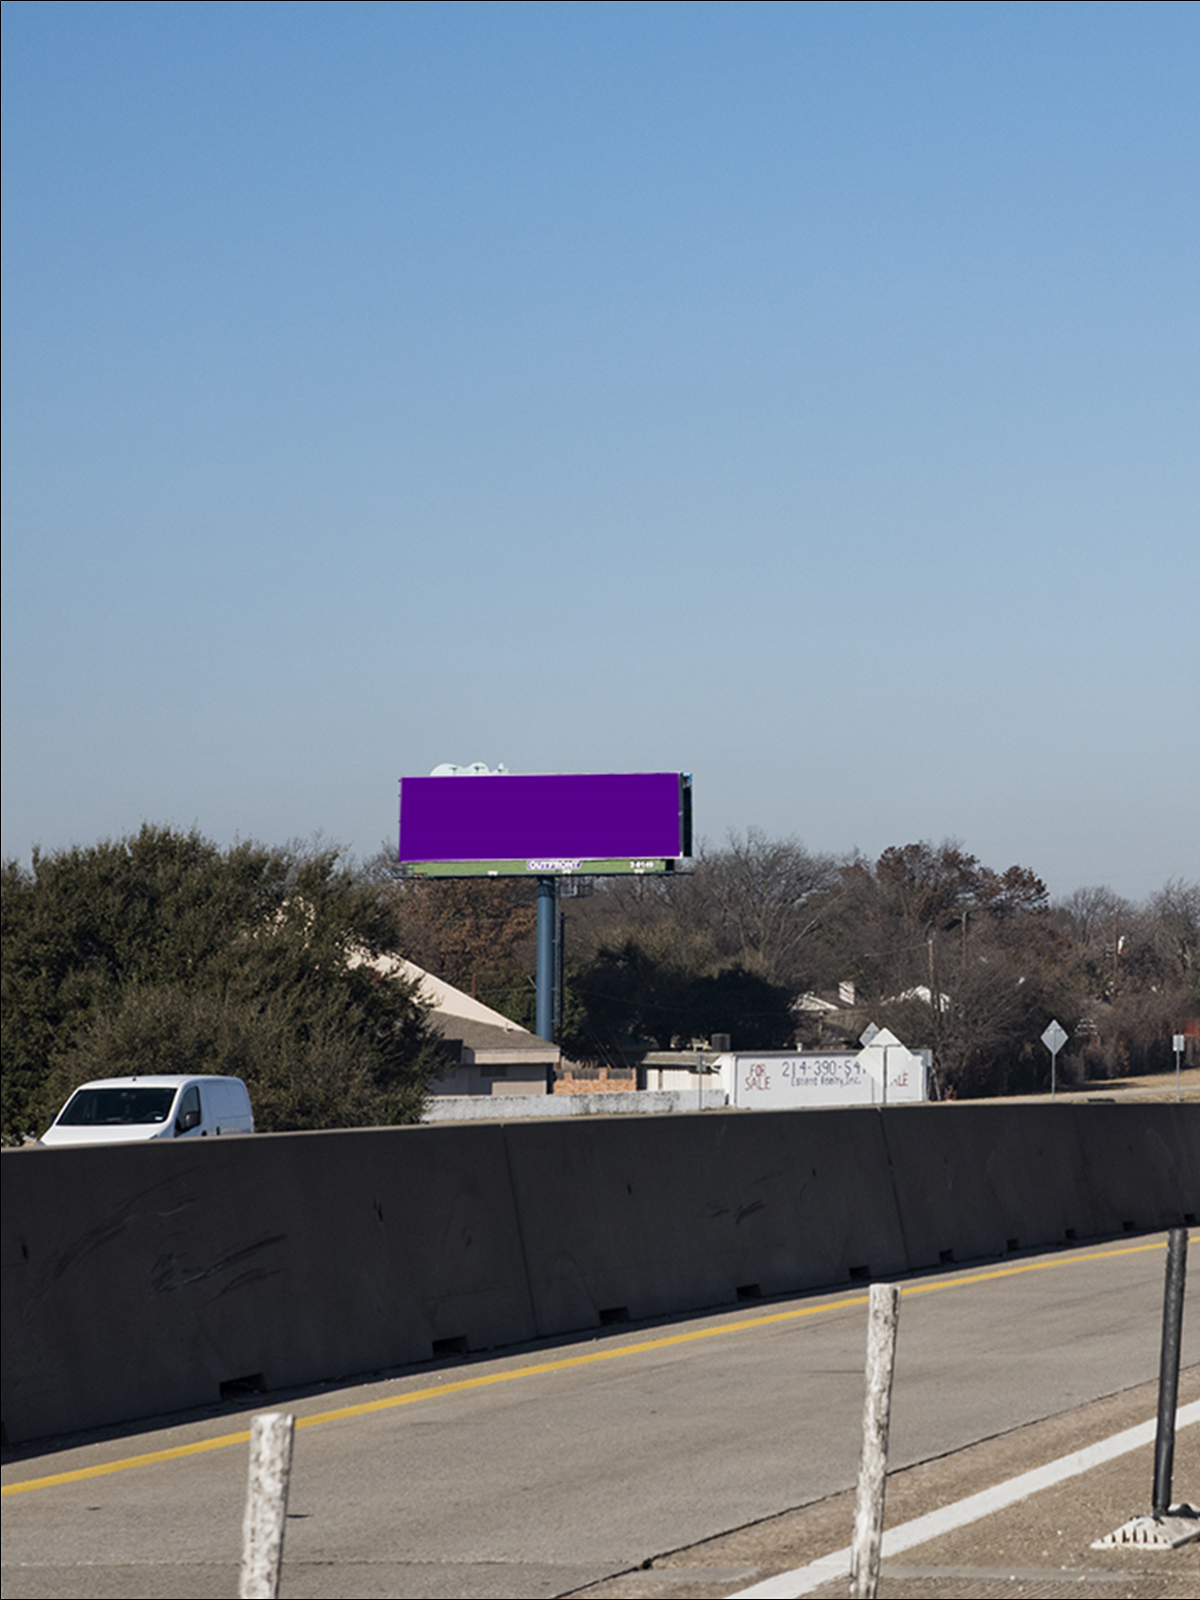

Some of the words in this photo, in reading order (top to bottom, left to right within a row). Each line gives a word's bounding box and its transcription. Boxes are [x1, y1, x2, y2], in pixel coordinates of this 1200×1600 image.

[750, 1064, 766, 1077] FOR
[782, 1060, 867, 1077] 214-390-54
[745, 1076, 771, 1091] SALE
